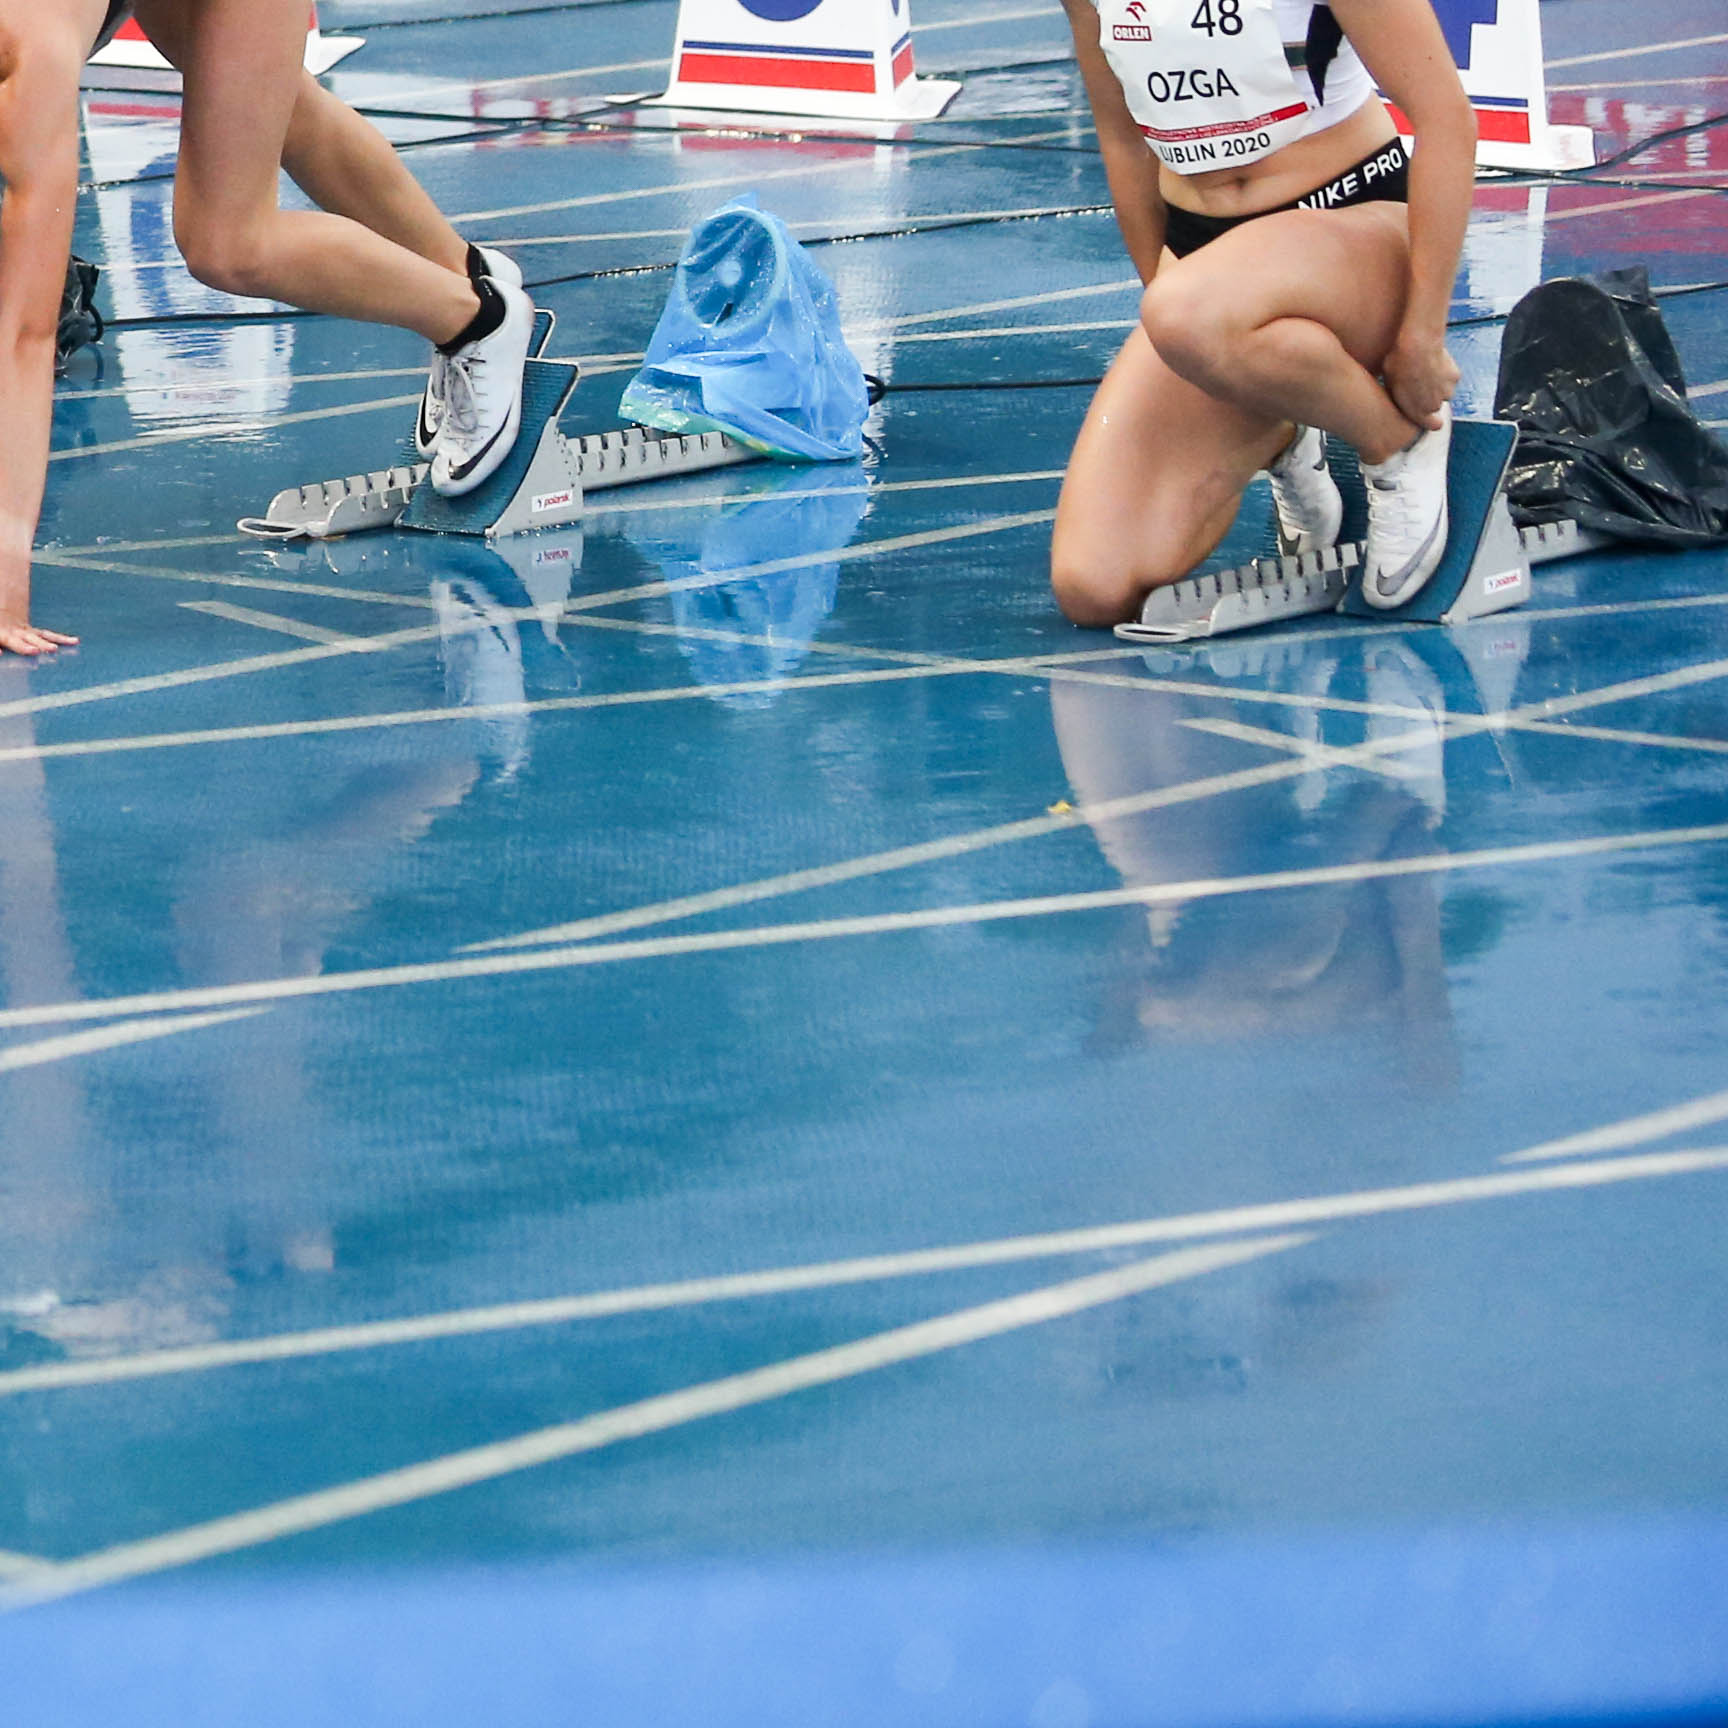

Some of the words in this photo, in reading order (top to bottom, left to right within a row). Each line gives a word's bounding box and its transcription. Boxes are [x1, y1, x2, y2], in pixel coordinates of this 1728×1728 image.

[1114, 26, 1150, 40] ORLEN
[1147, 68, 1240, 103] OZGA
[1159, 142, 1216, 164] LUBLIN
[1221, 132, 1271, 157] 2020
[1297, 172, 1359, 210] NIKE
[1362, 147, 1404, 184] PRO
